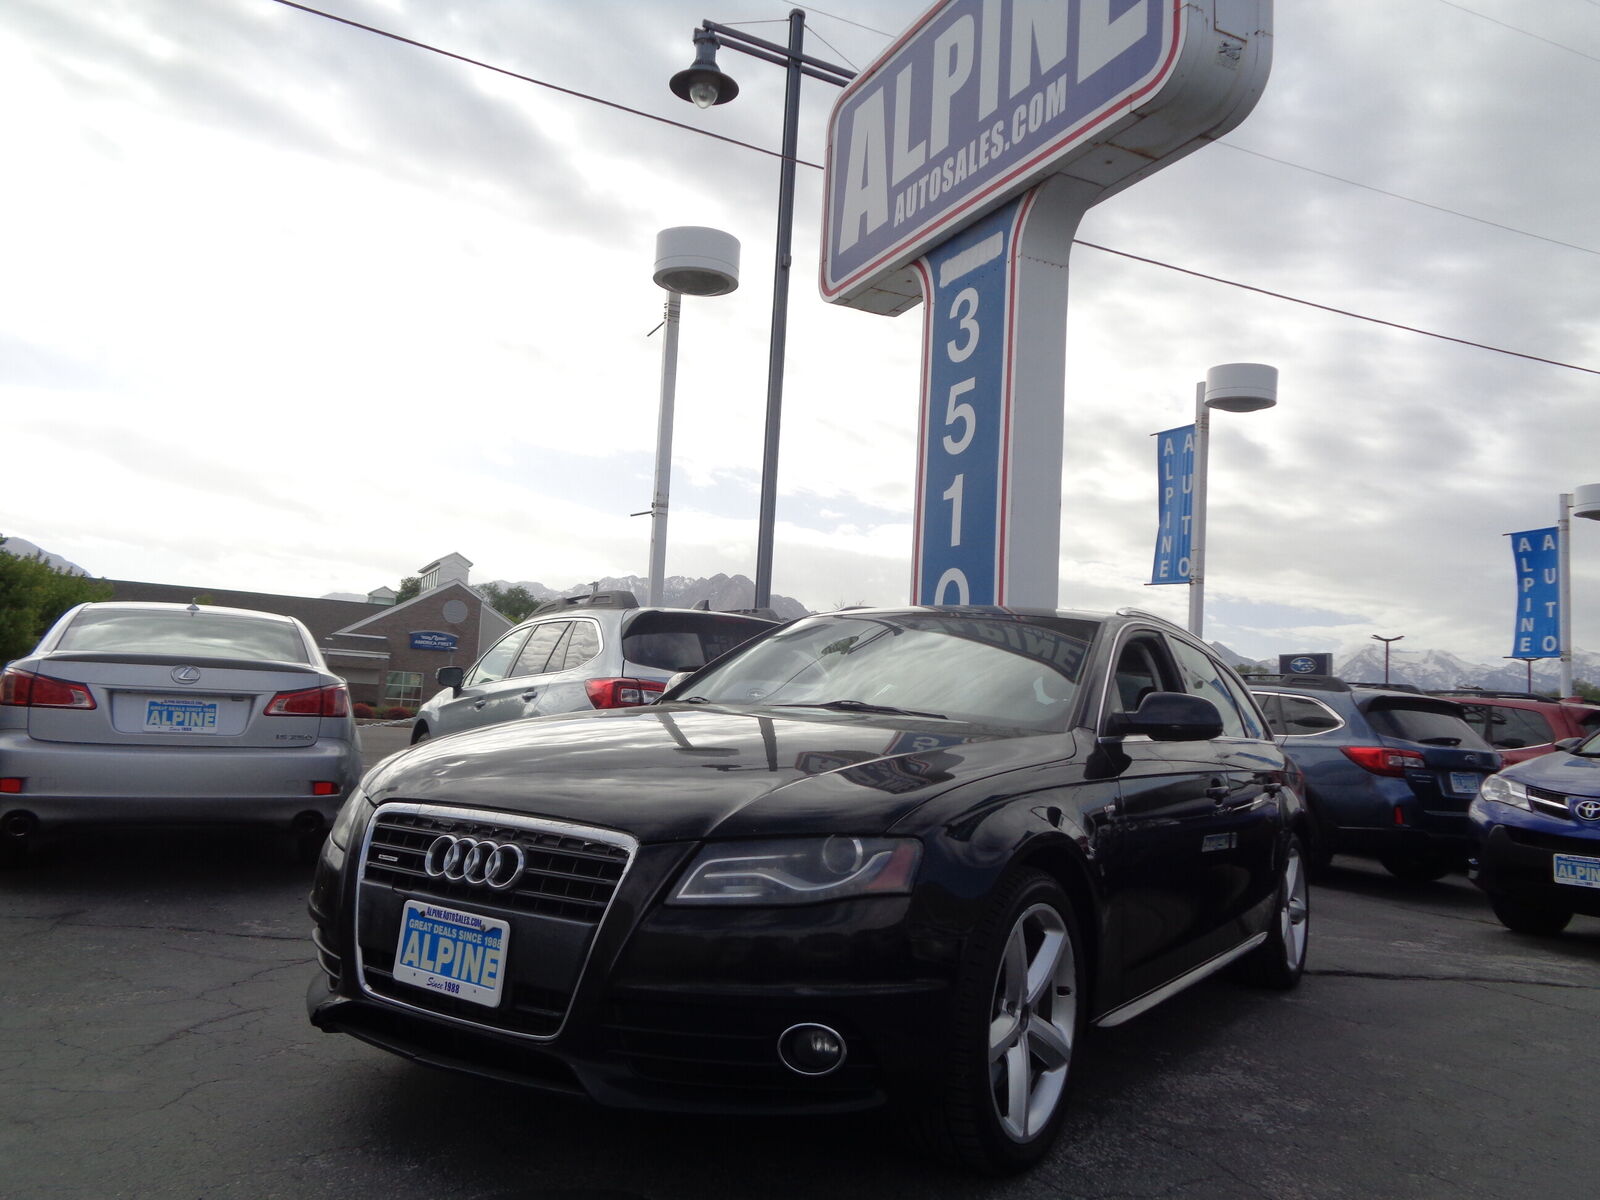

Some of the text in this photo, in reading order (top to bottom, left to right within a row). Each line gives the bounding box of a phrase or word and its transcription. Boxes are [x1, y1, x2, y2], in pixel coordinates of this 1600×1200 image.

[893, 73, 1067, 228] AUTOSALES.COM
[1158, 437, 1175, 579] ALPINE
[1177, 433, 1195, 578] AUTO
[1517, 537, 1534, 653] ALPINE
[1541, 534, 1558, 653] AUTO
[148, 711, 215, 728] ALPINE
[402, 931, 501, 988] ALPINE
[409, 918, 433, 933] GREAT
[433, 924, 457, 937] DEALS
[458, 930, 482, 944] SINCE
[426, 976, 461, 994] Since 1988
